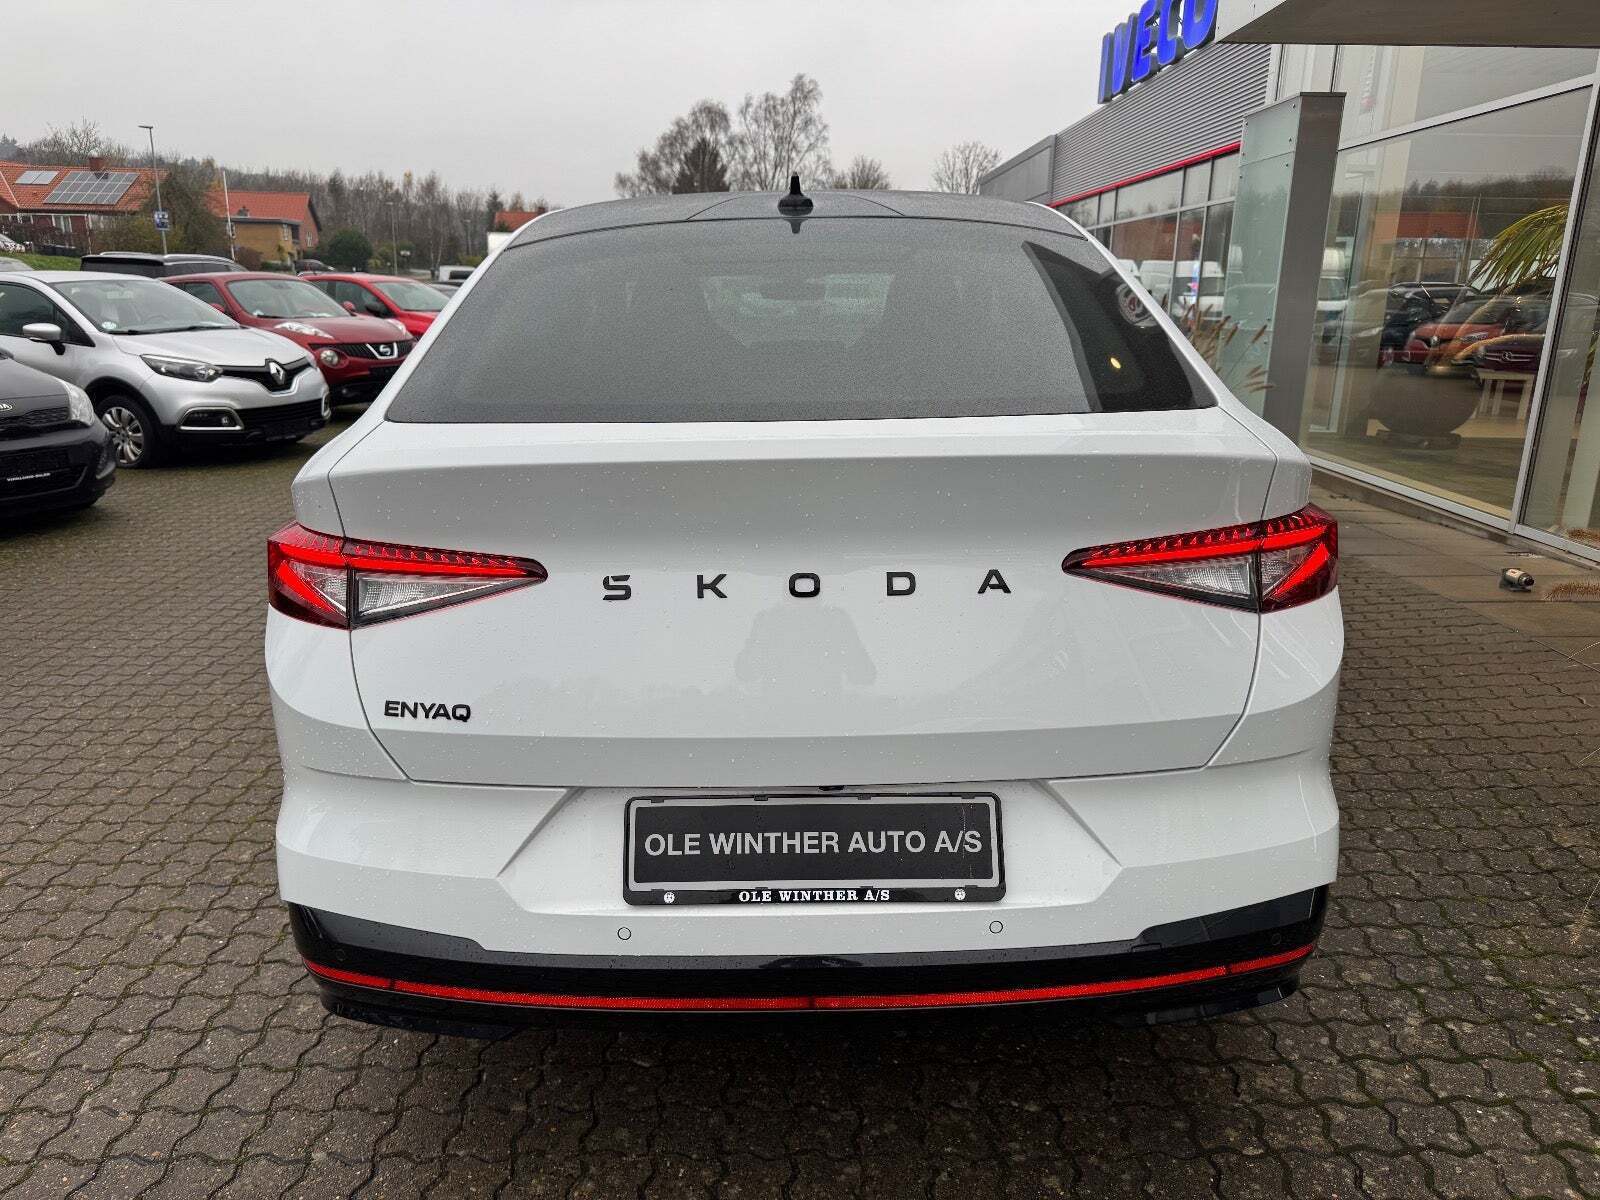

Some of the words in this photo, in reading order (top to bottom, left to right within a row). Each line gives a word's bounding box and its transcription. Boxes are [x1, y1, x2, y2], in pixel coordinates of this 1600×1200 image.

[1098, 0, 1218, 104] IVECO
[602, 568, 1012, 601] SKODA
[384, 700, 471, 722] ENYAQ
[644, 833, 701, 856] OLE
[708, 832, 840, 855] WINTHER
[847, 830, 926, 853] AUTO
[933, 830, 983, 853] A/S
[738, 890, 772, 902] OLE
[778, 889, 859, 902] WINTHER
[864, 889, 890, 902] A/S
